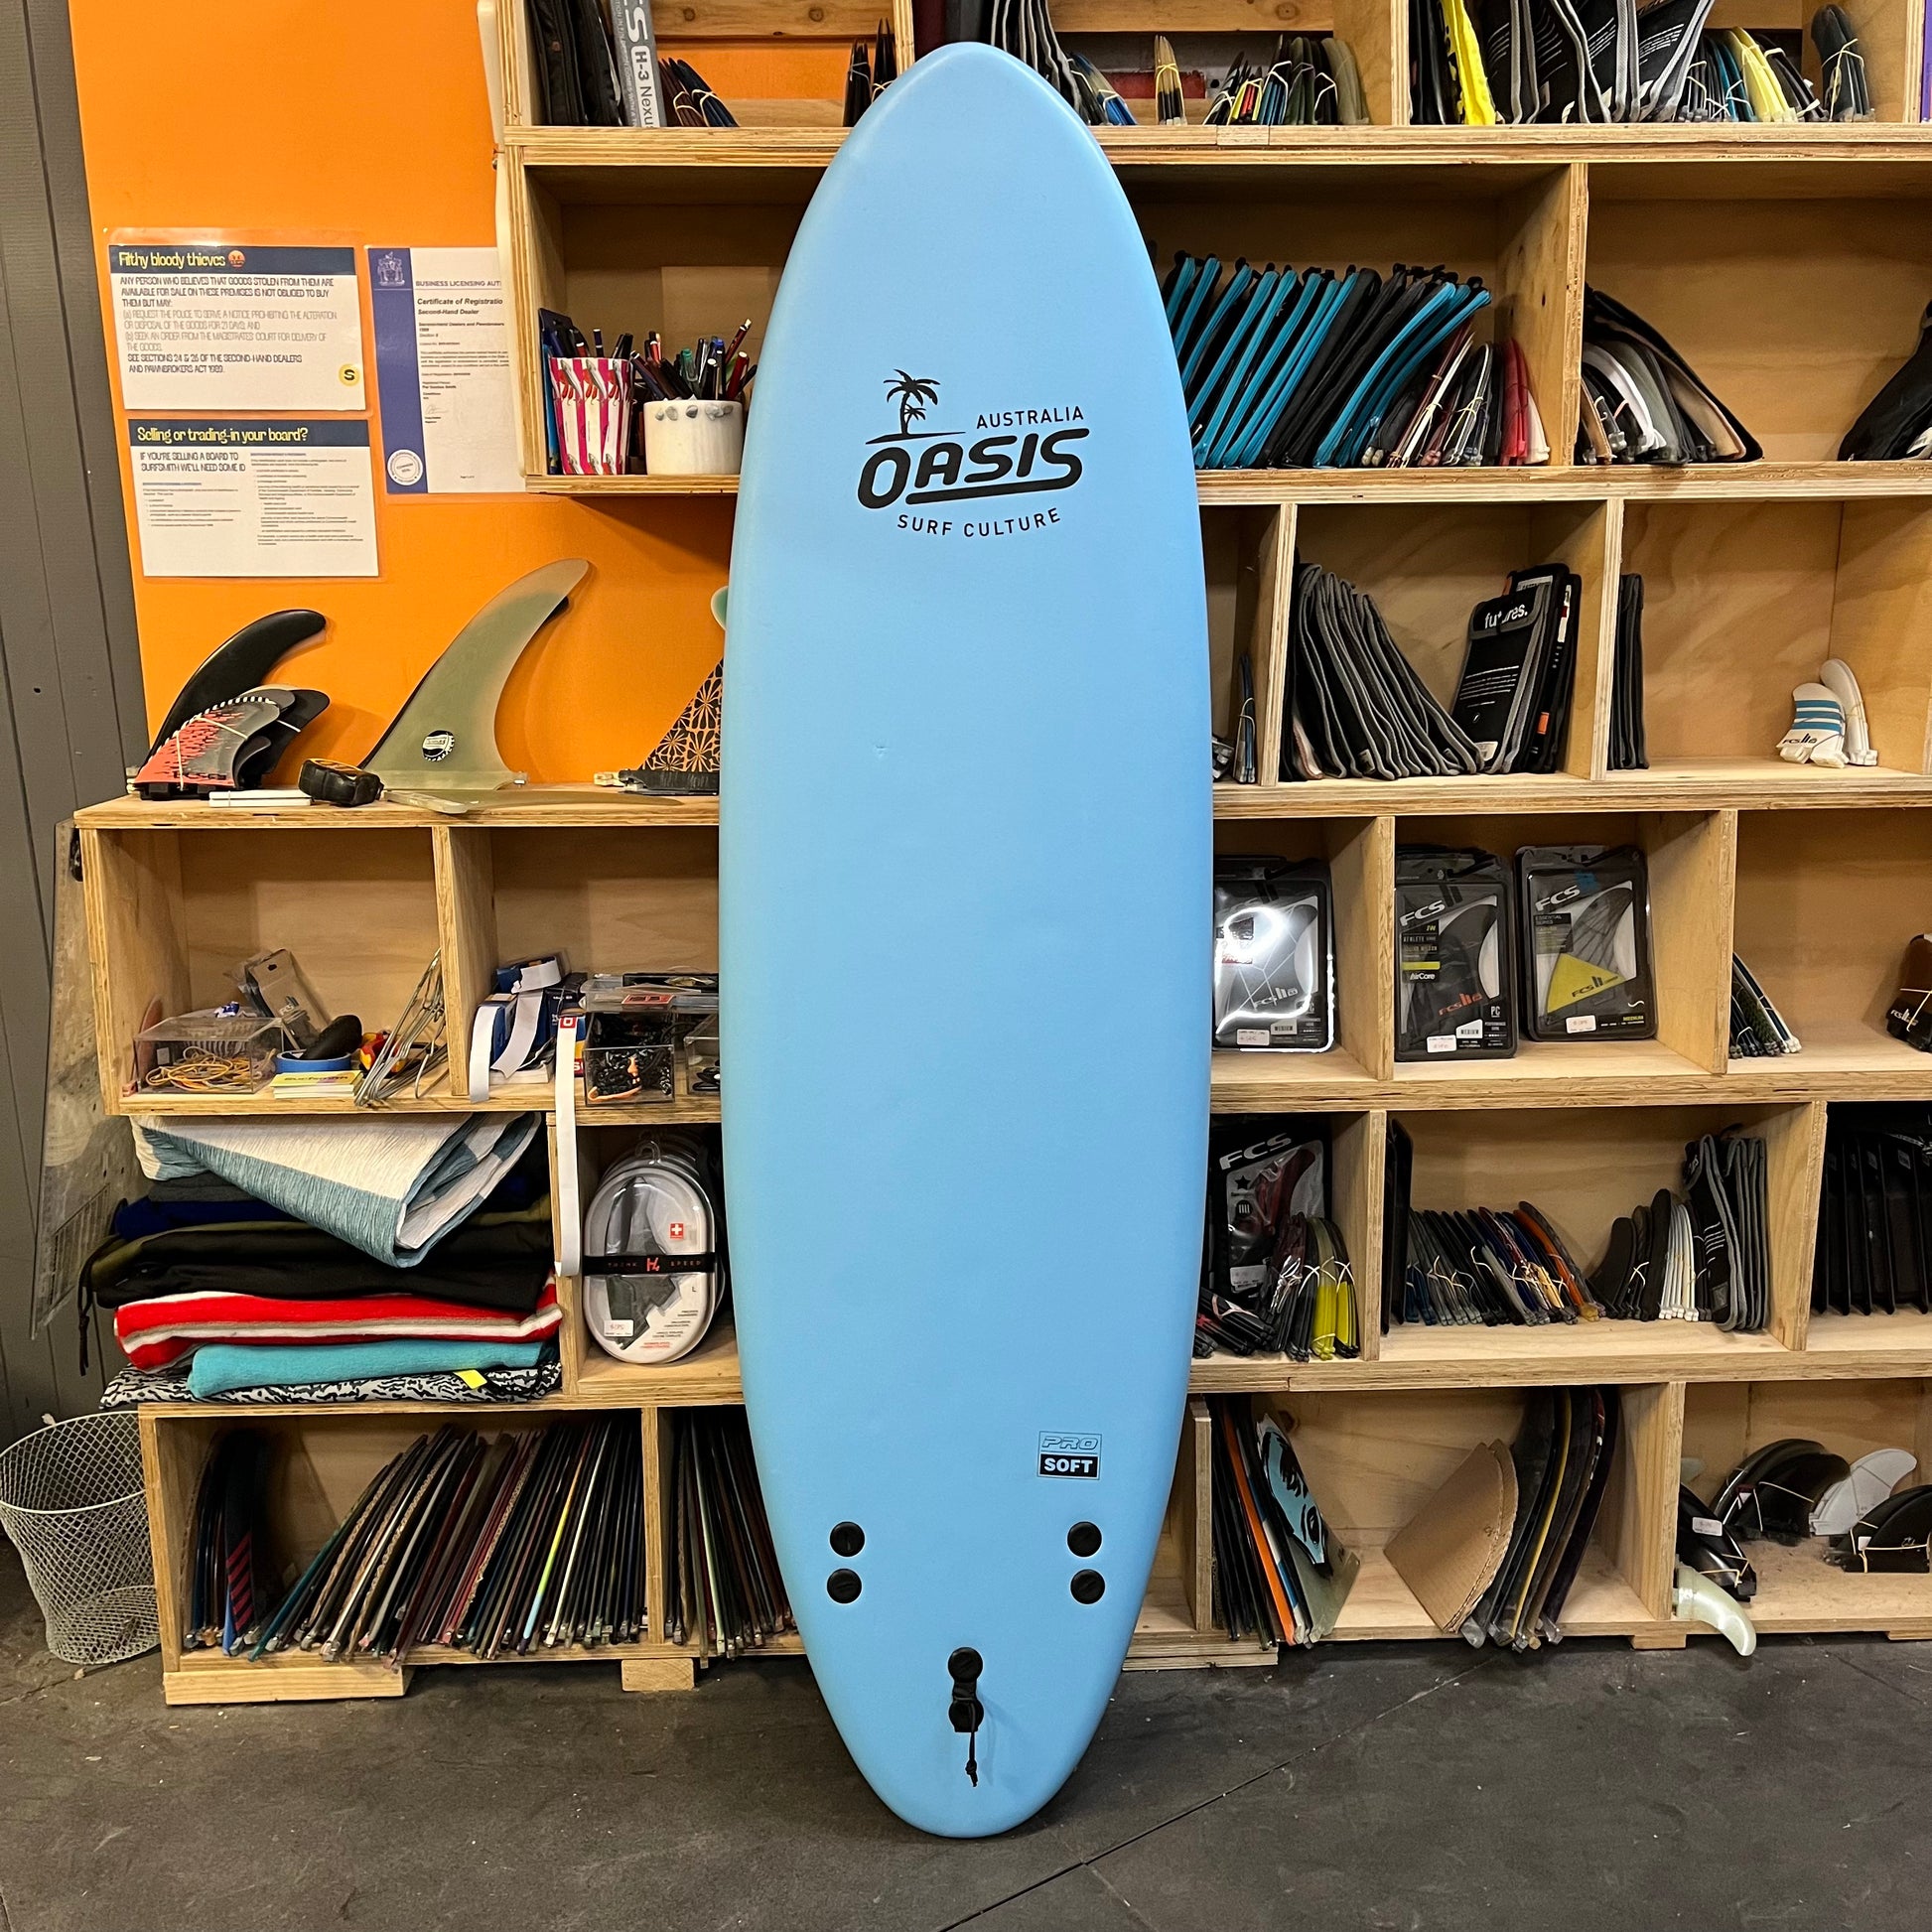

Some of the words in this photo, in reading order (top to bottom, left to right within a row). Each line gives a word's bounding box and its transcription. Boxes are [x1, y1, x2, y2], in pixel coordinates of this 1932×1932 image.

[634, 51, 649, 81] H-3
[119, 252, 148, 269] Filthy
[151, 252, 185, 269] bloody
[187, 252, 225, 266] thieves
[181, 277, 208, 286] BELIEVES
[121, 288, 155, 297] AVAILABLE
[157, 288, 169, 297] FOR
[171, 288, 186, 297] SALE
[188, 288, 198, 297] ON
[317, 289, 329, 298] BUY
[122, 299, 141, 308] THEM
[143, 299, 156, 308] BUT
[133, 310, 159, 319] REQUEST
[161, 310, 171, 319] THE
[173, 310, 193, 319] POLICE
[194, 310, 203, 319] TO
[290, 311, 301, 320] THE
[303, 311, 338, 320] ALTERATION
[174, 321, 184, 330] THE
[187, 321, 207, 331] GOODS
[201, 332, 211, 342] THE
[255, 332, 276, 342] COURT
[278, 332, 290, 342] FOR
[319, 332, 327, 342] OF
[127, 343, 137, 351] THE
[128, 353, 139, 362] SEE
[274, 354, 303, 363] DEALERS
[344, 369, 355, 381] S
[976, 406, 1084, 429] AUSTRALIA
[137, 427, 173, 445] Selling
[173, 431, 187, 442] or
[189, 428, 240, 445] trading-in
[241, 431, 266, 445] your
[268, 427, 309, 442] board?
[141, 463, 179, 473] SURFSMITH
[201, 463, 218, 473] NEED
[218, 463, 237, 473] SOME
[238, 463, 246, 473] ID
[857, 428, 1090, 509] OASIS
[897, 514, 953, 536] SURF
[963, 507, 1061, 537] CULTURE
[1535, 885, 1581, 911] FCS
[1400, 899, 1446, 927] FCS
[1572, 985, 1594, 998] FCS
[1490, 1006, 1501, 1016] PC
[1219, 1132, 1292, 1171] FCS
[1041, 1436, 1098, 1449] PRO
[1044, 1457, 1093, 1473] SOFT
